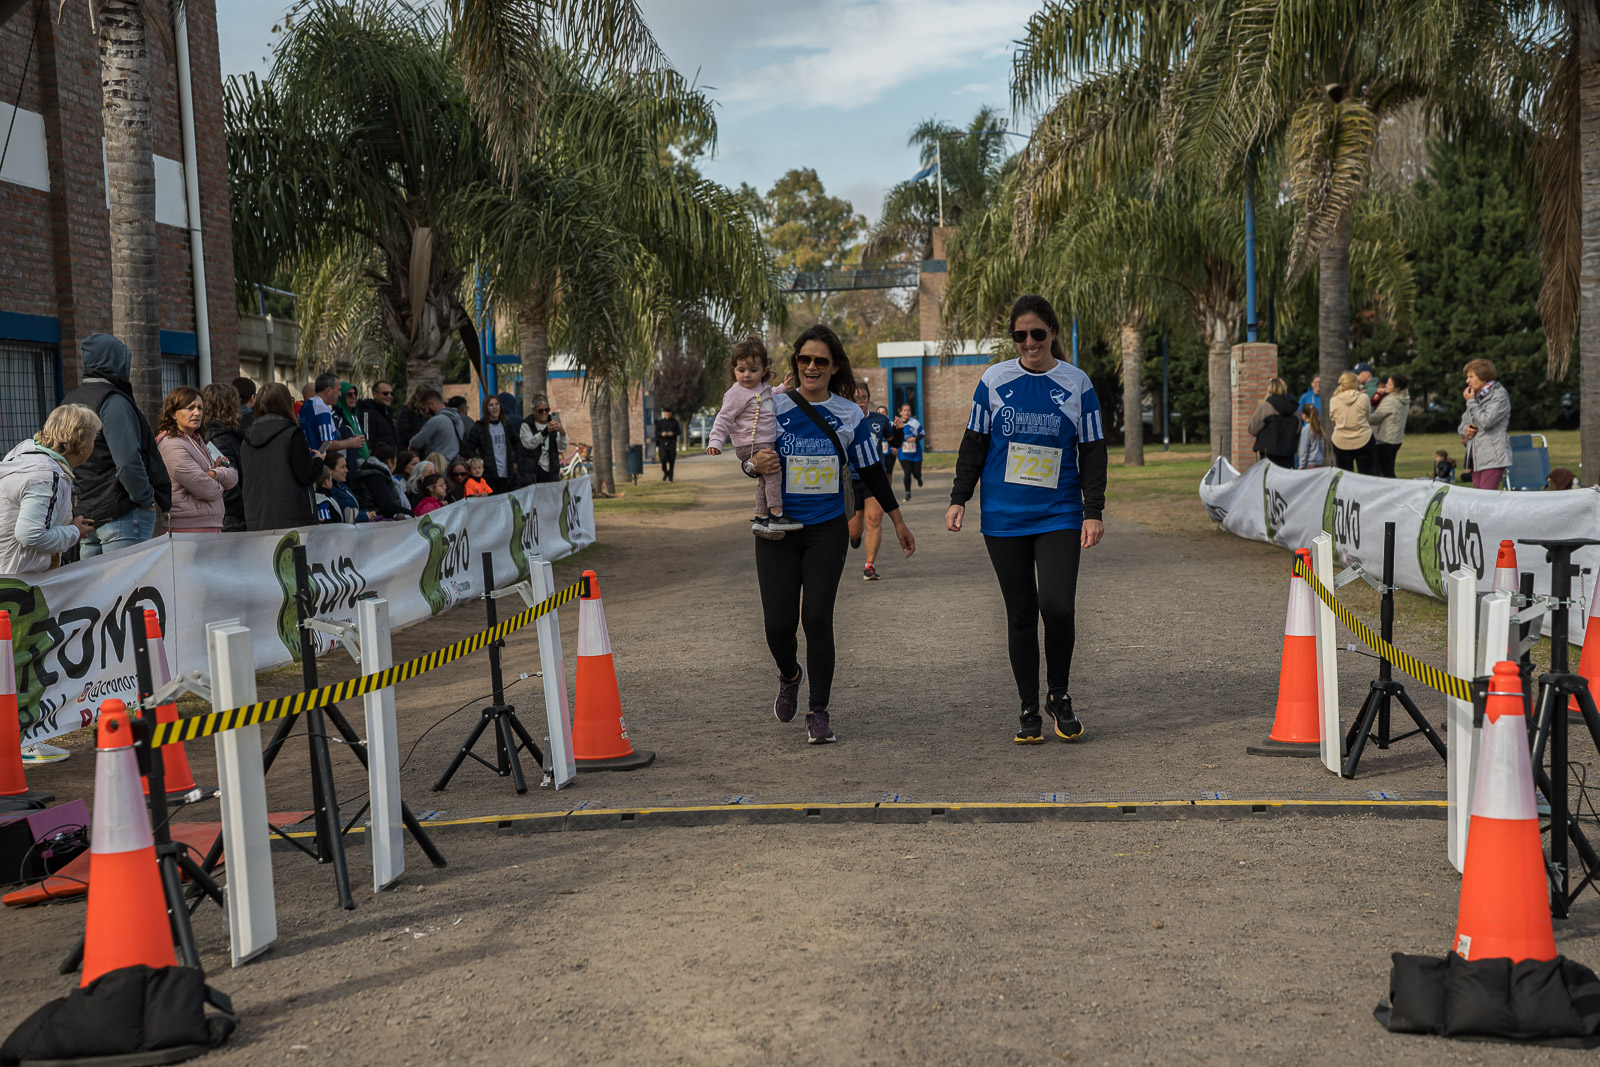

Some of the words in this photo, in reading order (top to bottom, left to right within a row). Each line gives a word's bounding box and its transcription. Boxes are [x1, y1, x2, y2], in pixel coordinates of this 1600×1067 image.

[1001, 406, 1015, 436] 3
[780, 431, 795, 457] 3
[791, 466, 835, 486] 709
[1012, 454, 1054, 478] 725
[87, 674, 139, 703] @cronor
